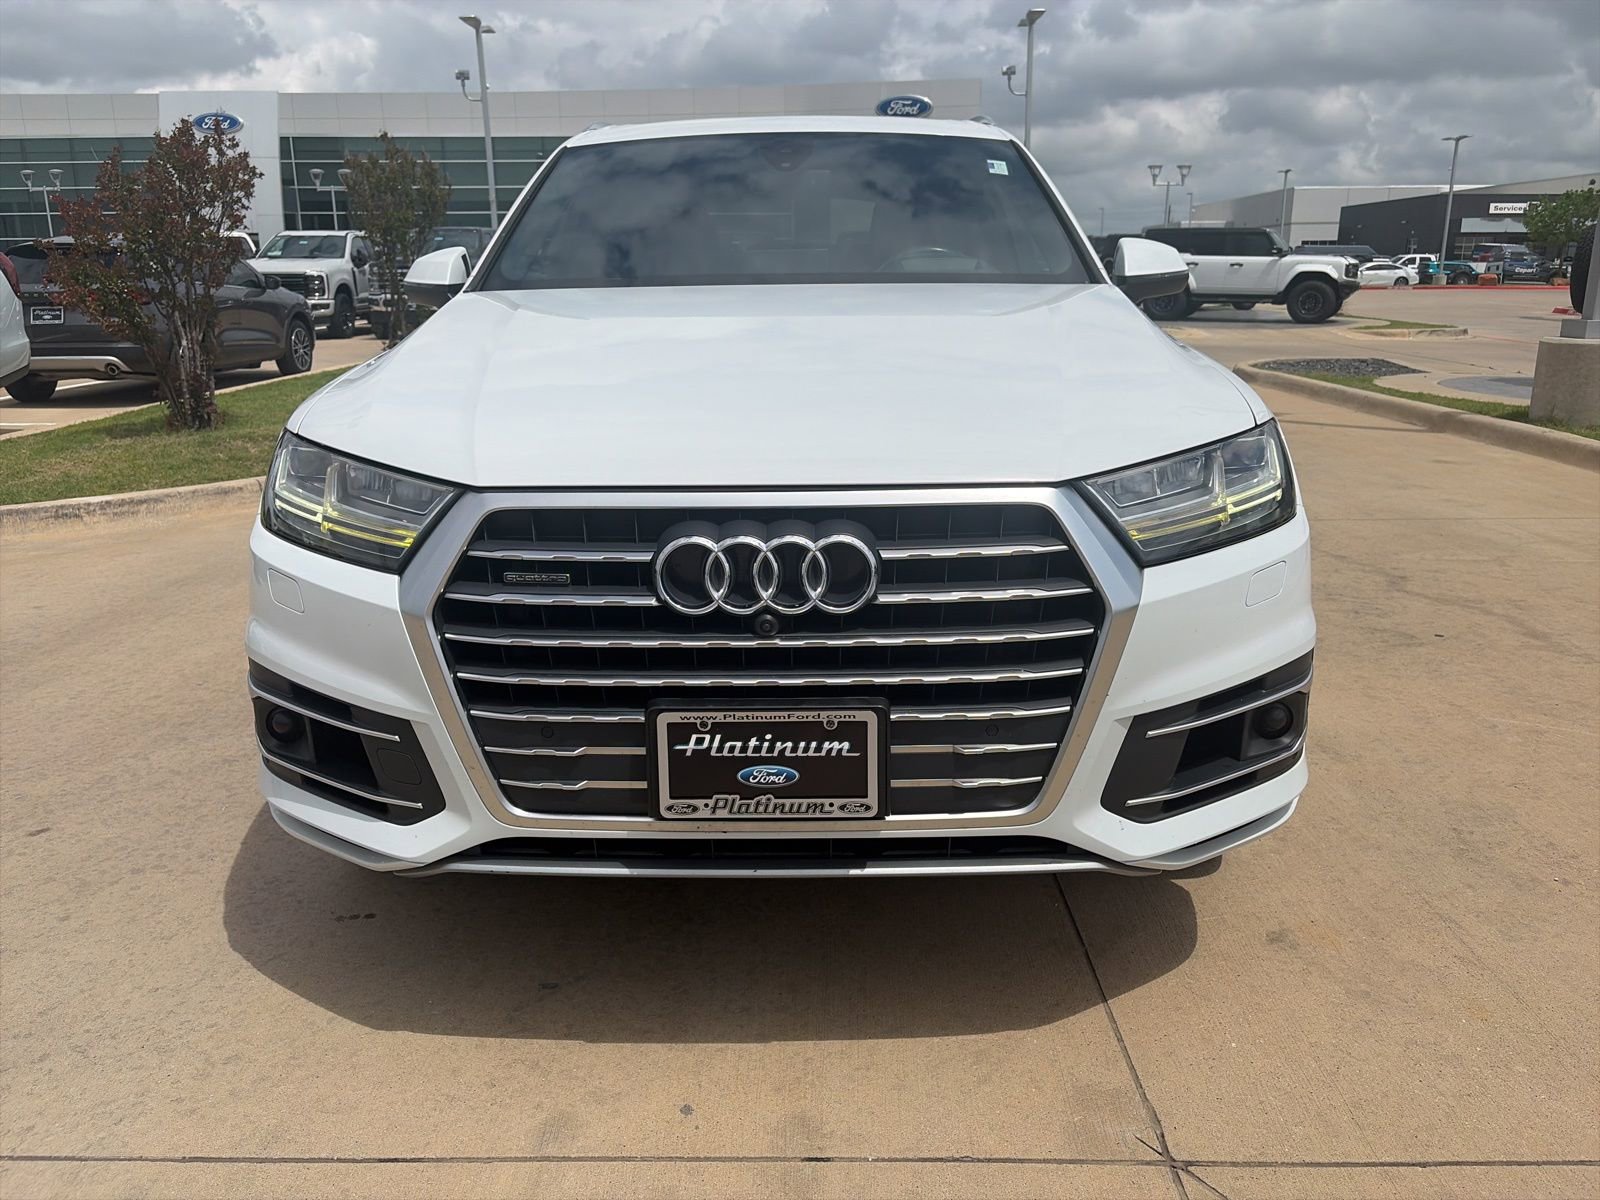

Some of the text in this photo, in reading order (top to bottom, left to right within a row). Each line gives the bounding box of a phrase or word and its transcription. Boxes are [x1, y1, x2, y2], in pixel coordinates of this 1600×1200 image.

[887, 99, 921, 115] Ford
[679, 712, 856, 721] www.PlatinumFord.com
[672, 733, 861, 757] Platinum
[749, 768, 787, 784] Ford
[671, 804, 694, 814] Ford
[844, 803, 866, 813] Ford
